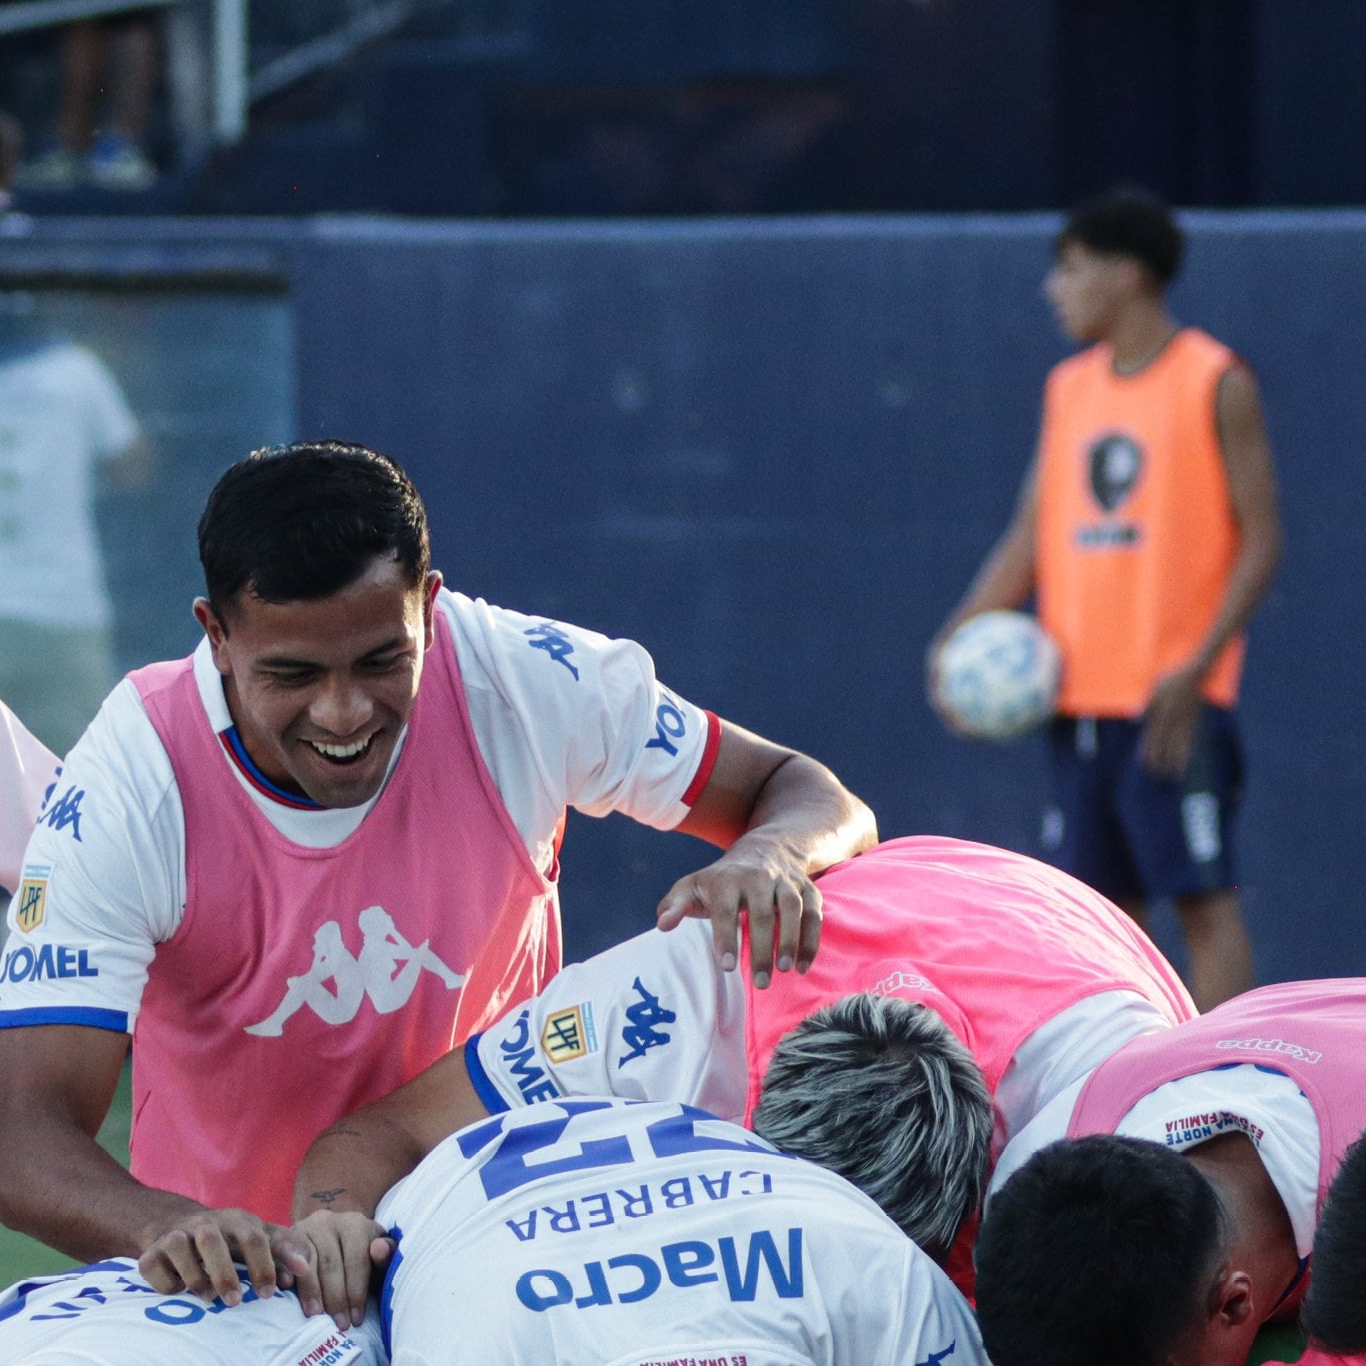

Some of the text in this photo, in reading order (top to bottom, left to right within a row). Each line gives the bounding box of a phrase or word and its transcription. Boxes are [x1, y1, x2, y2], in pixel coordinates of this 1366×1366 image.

[1215, 1038, 1323, 1065] Kappa
[1165, 1111, 1219, 1133] FAMILIA
[1165, 1125, 1213, 1146] NORTE
[506, 1170, 773, 1242] CABRERA
[516, 1227, 804, 1312] Macro
